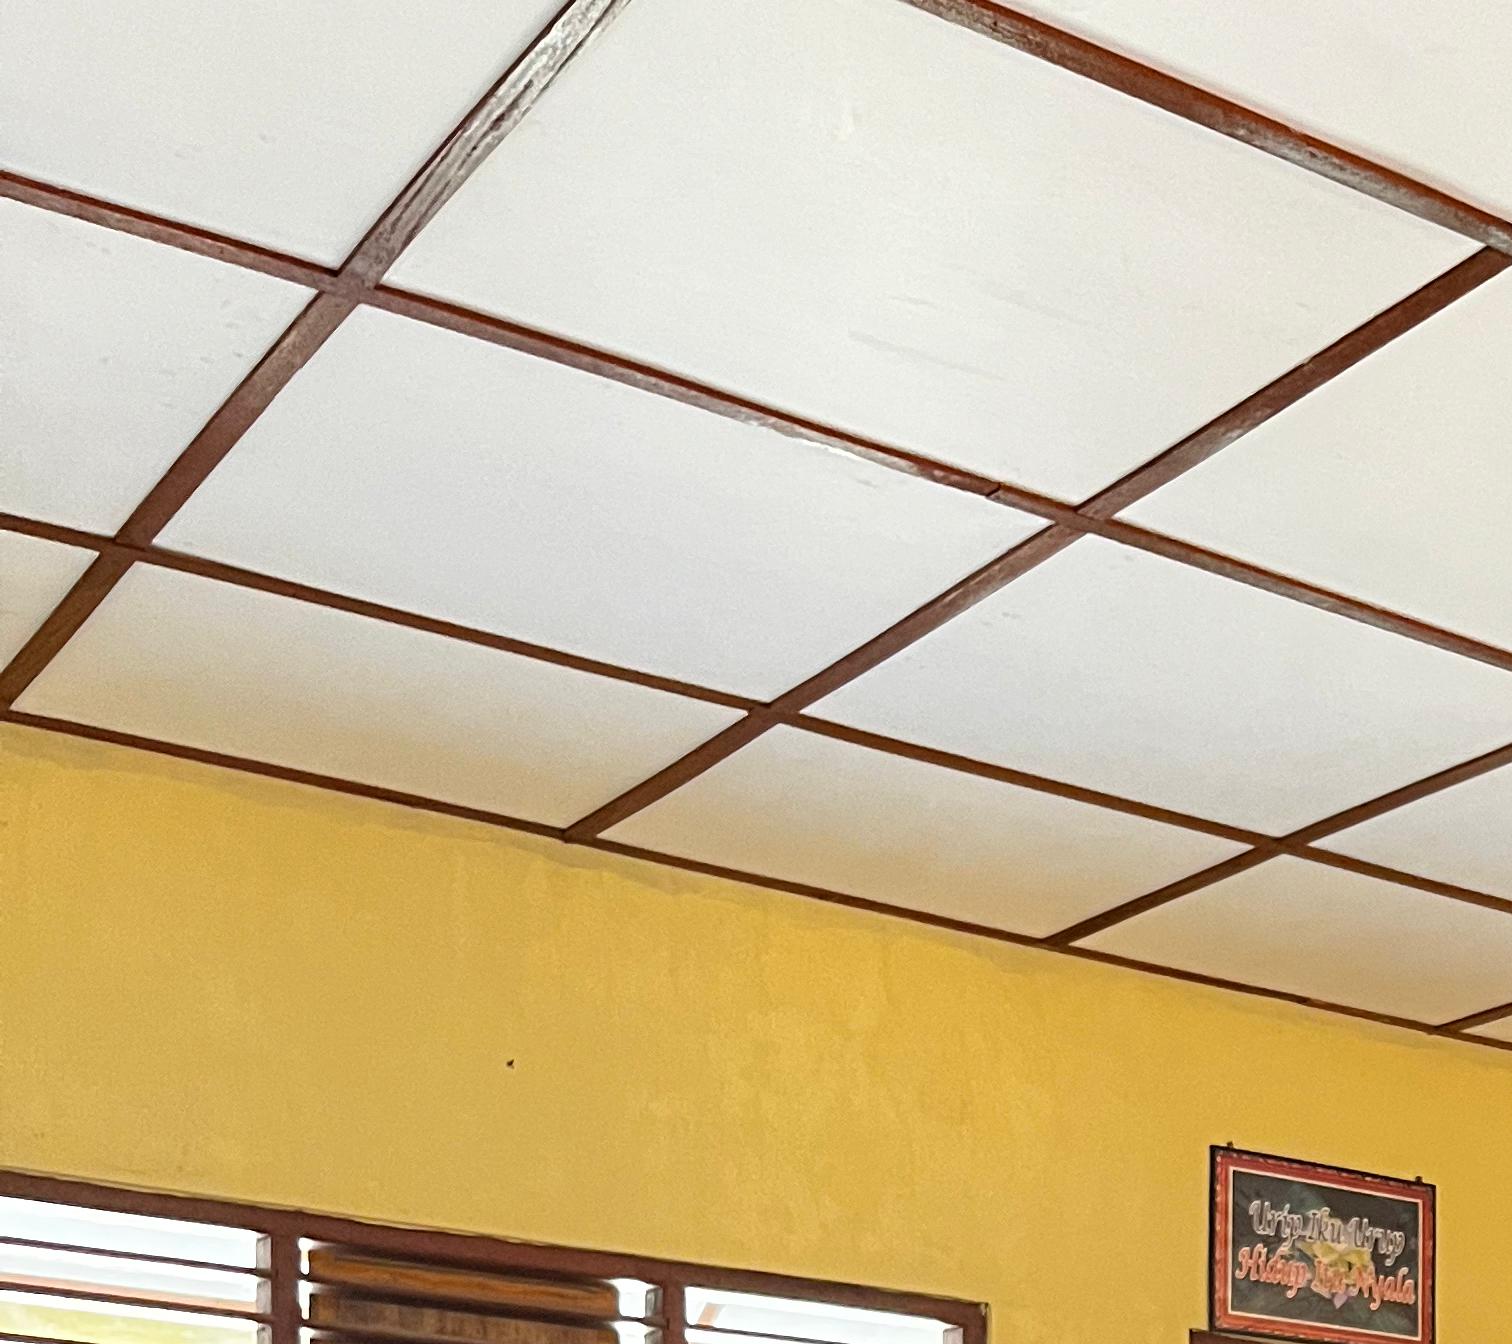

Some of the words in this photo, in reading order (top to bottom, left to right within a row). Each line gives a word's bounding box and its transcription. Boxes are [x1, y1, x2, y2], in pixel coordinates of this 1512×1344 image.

[1249, 1200, 1303, 1248] Urip
[1305, 1207, 1346, 1246] Iku
[1349, 1216, 1406, 1266] Urup
[1234, 1243, 1312, 1299] Hidup
[1345, 1265, 1417, 1311] Nyala
